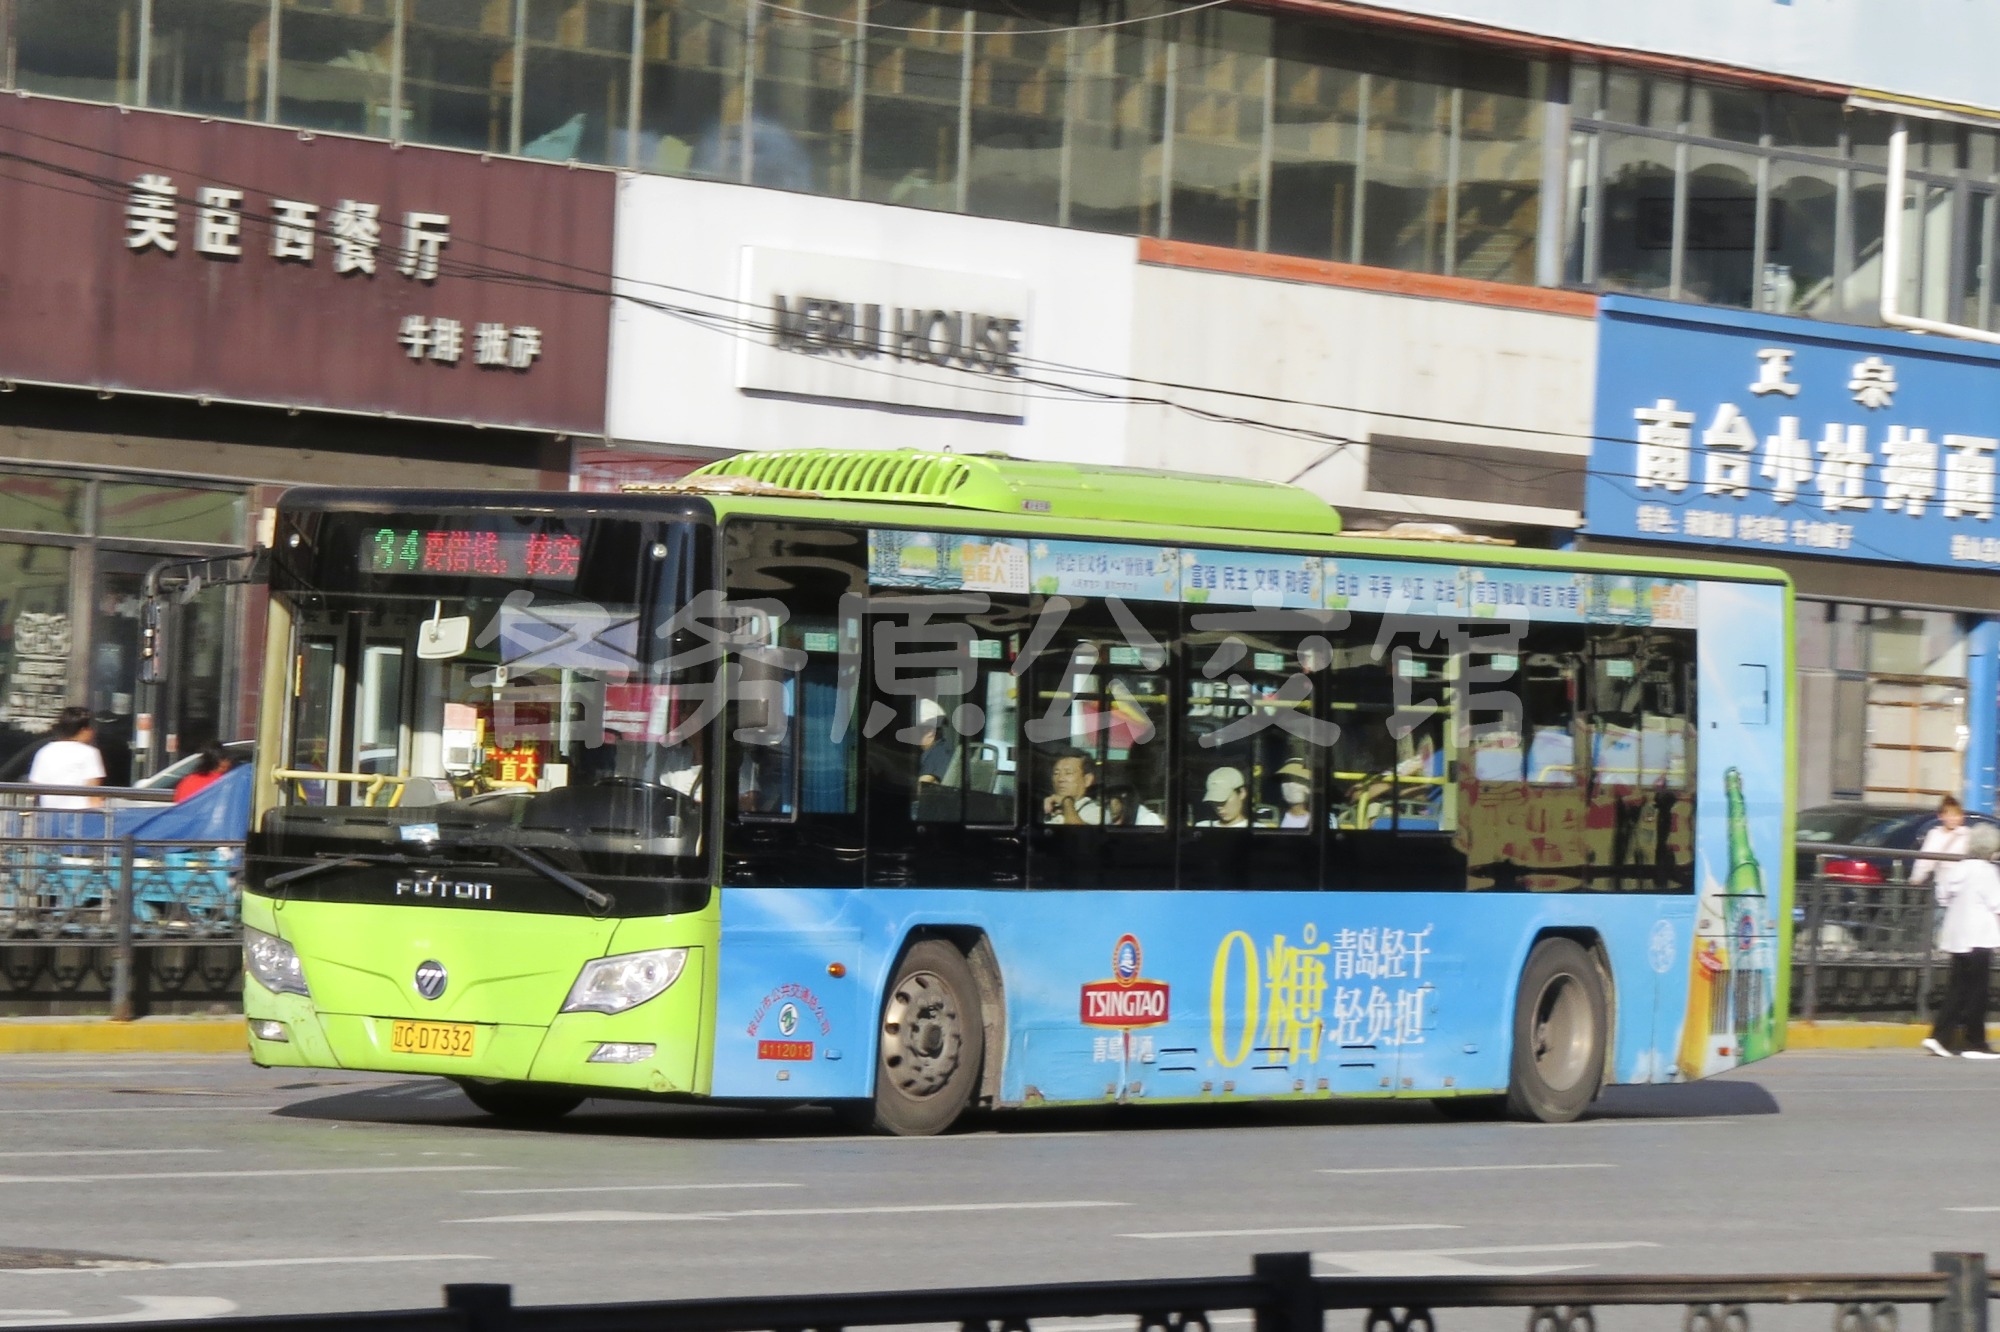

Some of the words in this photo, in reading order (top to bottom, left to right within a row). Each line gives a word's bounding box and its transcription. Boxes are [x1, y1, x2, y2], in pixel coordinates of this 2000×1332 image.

[893, 307, 1021, 376] HOUSE
[1750, 348, 1898, 408] 正宗
[375, 529, 419, 570] 34
[1192, 564, 1216, 589] 富强
[1224, 566, 1248, 590] 民主
[1253, 568, 1279, 592] 文明
[1285, 569, 1311, 595] 和谐
[1336, 574, 1358, 597] 自由
[1368, 575, 1392, 599] 平等
[396, 879, 493, 900] FOTON
[1085, 989, 1167, 1017] TSINGTAO
[1328, 981, 1427, 1047] 轻负担
[760, 1043, 812, 1058] 4112013
